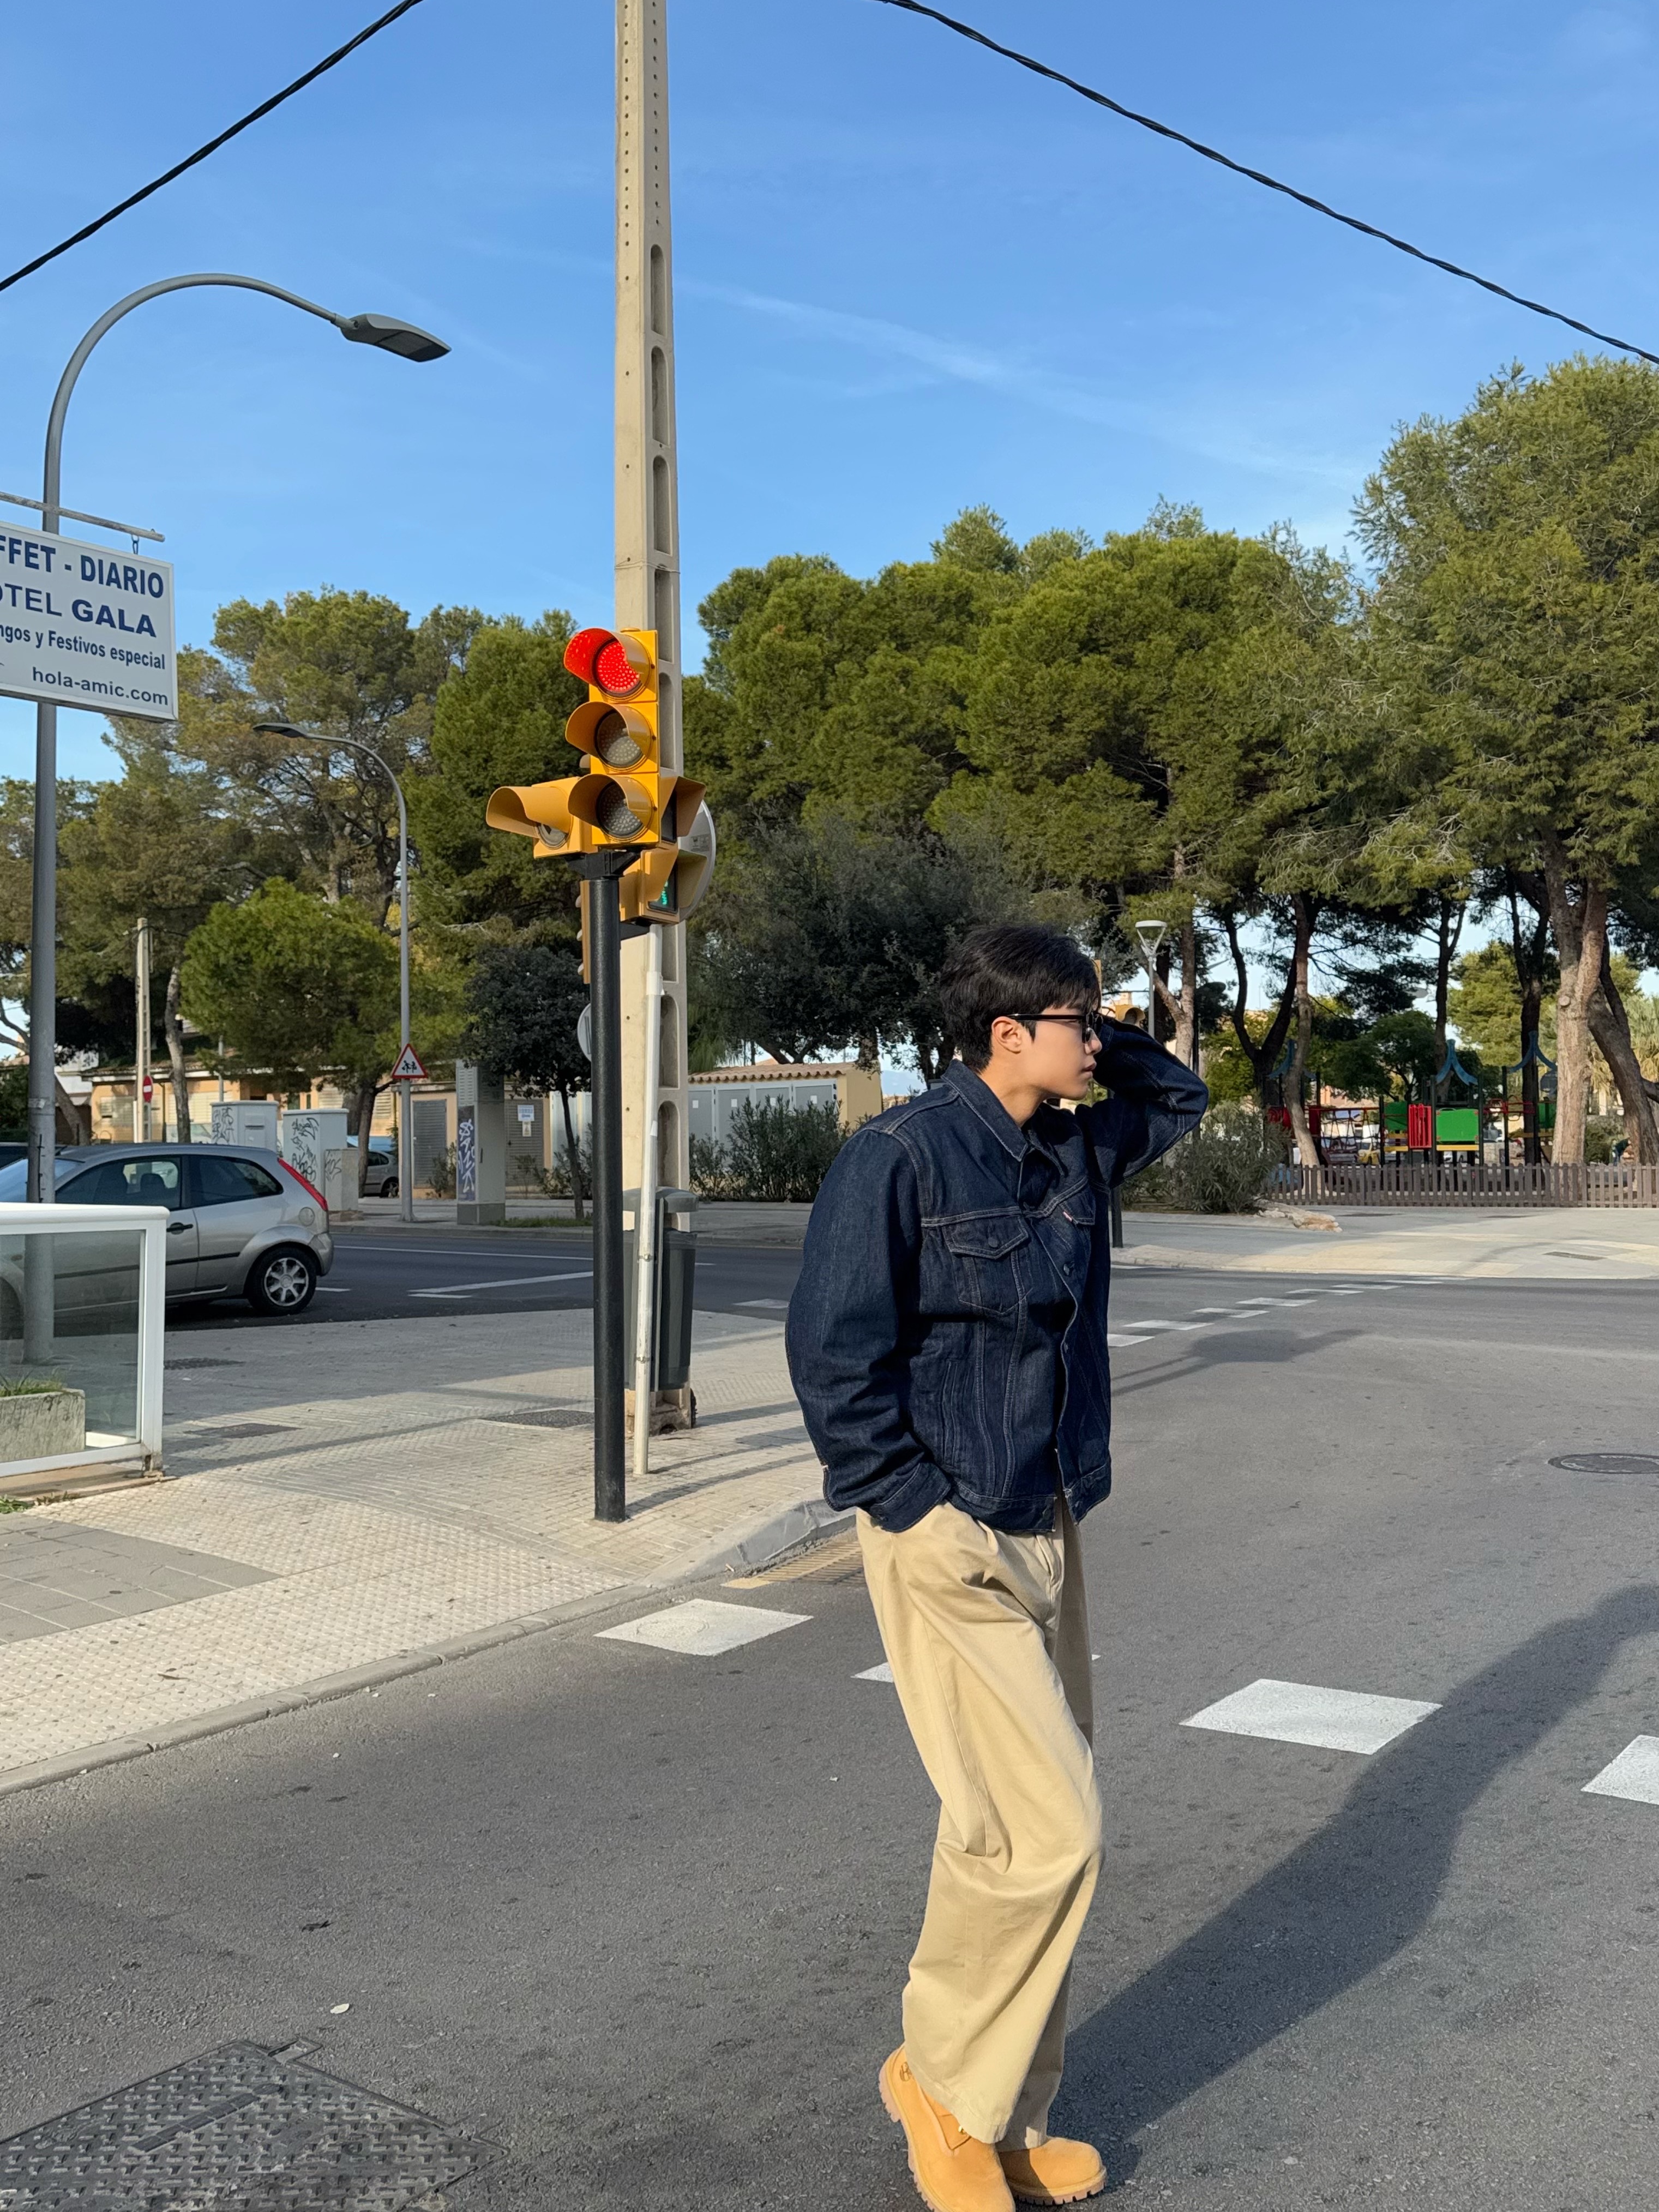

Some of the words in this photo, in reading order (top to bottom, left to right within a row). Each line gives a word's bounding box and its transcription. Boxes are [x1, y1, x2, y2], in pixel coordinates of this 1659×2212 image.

[80, 555, 164, 598] DIARIO
[0, 583, 62, 617] TEL
[71, 599, 157, 638] GALA
[35, 632, 44, 649] y
[49, 630, 105, 657] Festivos
[110, 647, 165, 670] especial
[33, 666, 168, 706] hola-amic.com
